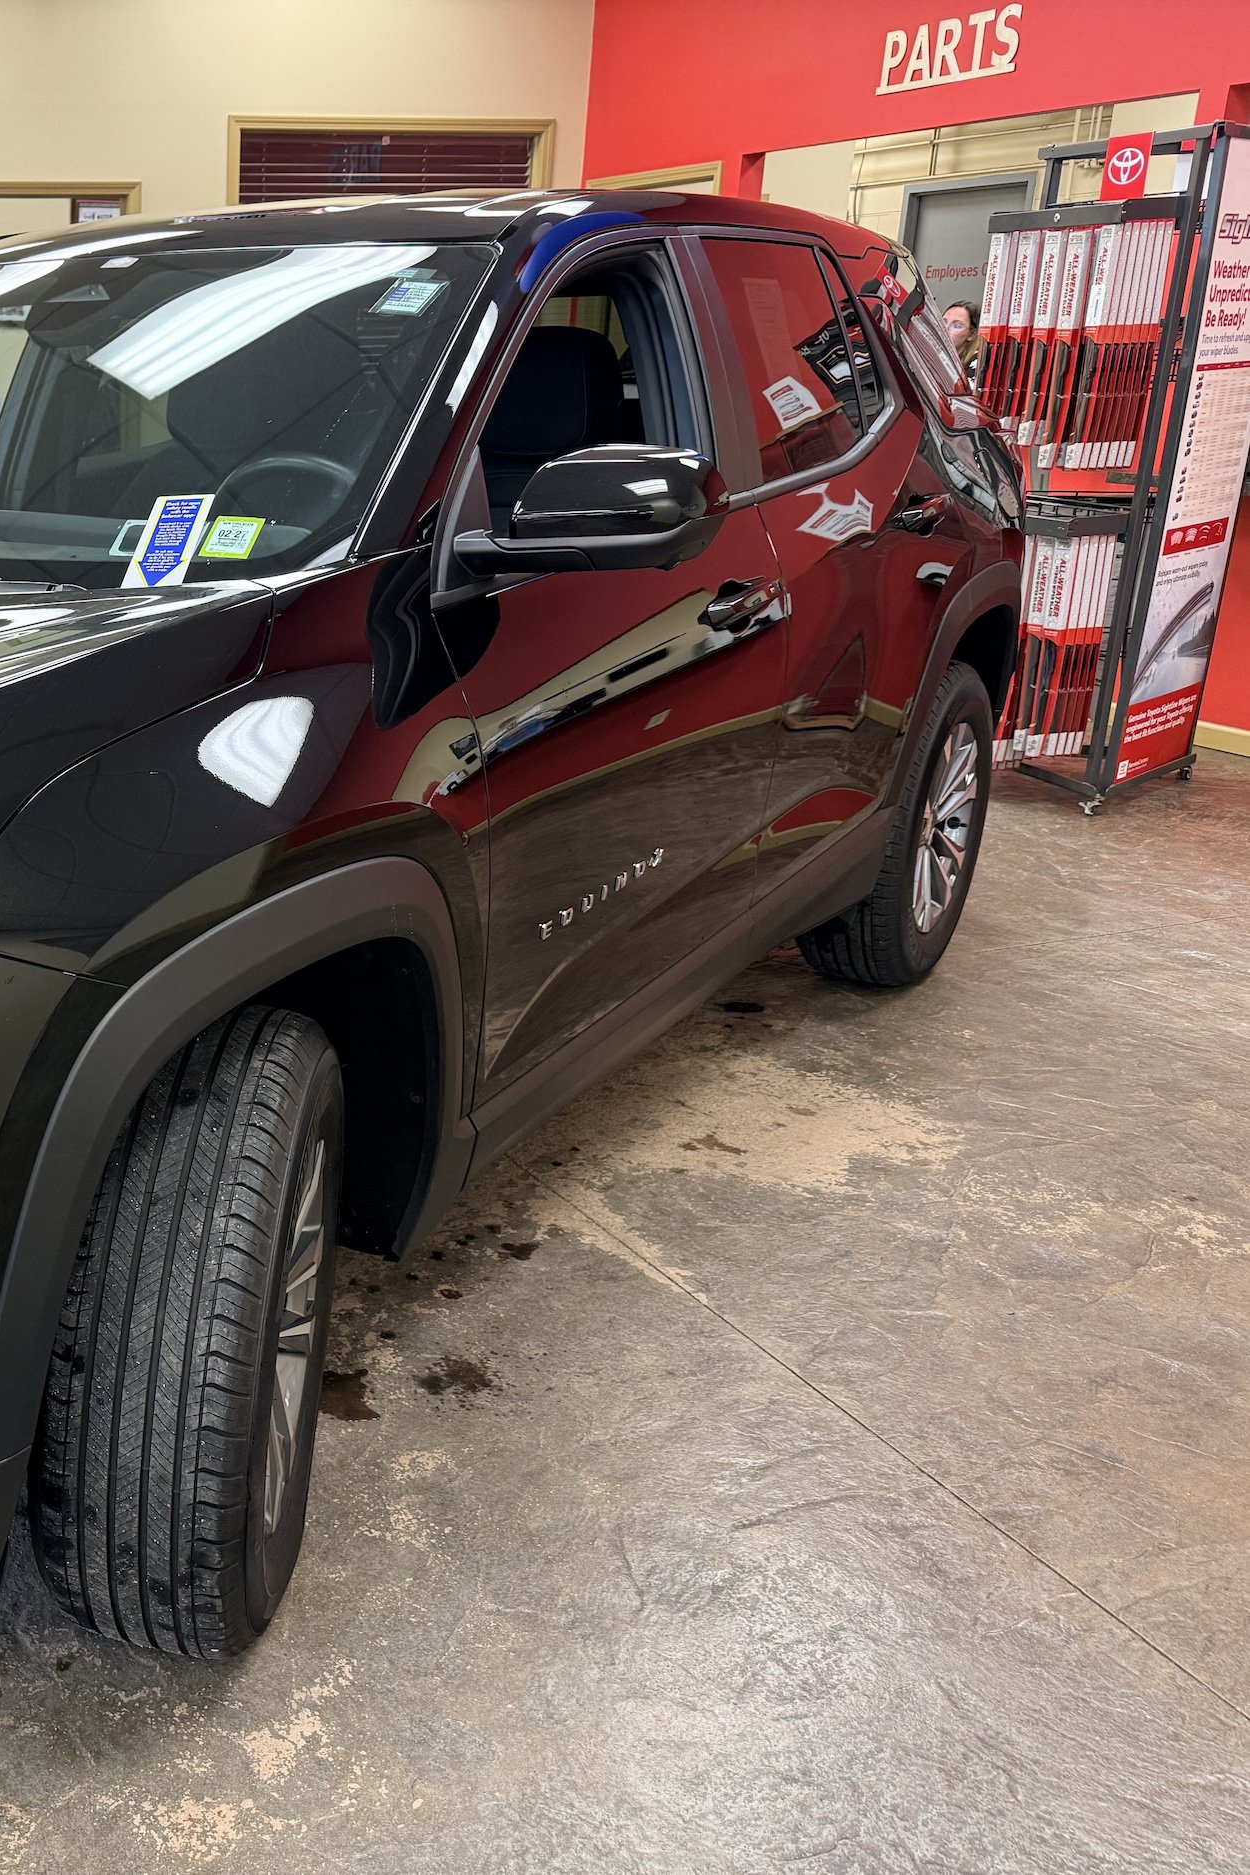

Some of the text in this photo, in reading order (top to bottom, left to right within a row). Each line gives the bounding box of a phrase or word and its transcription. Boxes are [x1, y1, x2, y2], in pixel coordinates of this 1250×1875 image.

[879, 3, 1023, 88] PARTS
[925, 264, 978, 282] Employees
[986, 254, 999, 315] ALL-WEATHER
[1015, 254, 1028, 315] ALL-WEATHER
[1041, 253, 1055, 316] ALL-WEATHER
[1065, 254, 1079, 316] ALL-WEATHER
[1213, 259, 1250, 278] Weather
[1202, 334, 1213, 343] Time
[1219, 332, 1235, 342] refresh
[1235, 331, 1244, 341] and
[1205, 307, 1247, 330] Be Ready!
[1199, 349, 1209, 359] your
[1210, 345, 1223, 358] wiper
[1036, 555, 1049, 613] ALL-WEATHER
[1053, 559, 1067, 618] ALL-WEATHER
[1128, 712, 1147, 723] Genuine
[1147, 707, 1161, 717] Toyota
[1156, 715, 1167, 725] your
[538, 847, 664, 940] EQUINOX
